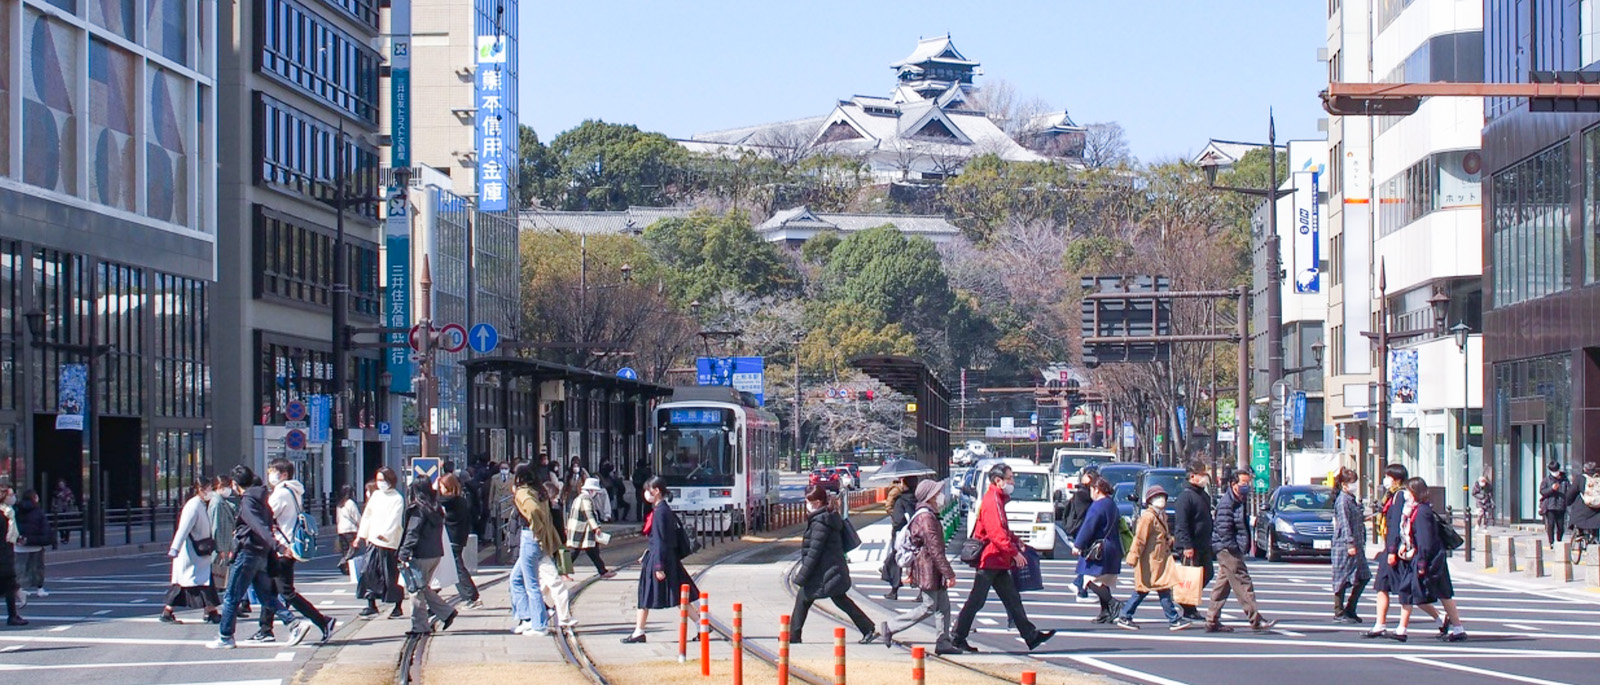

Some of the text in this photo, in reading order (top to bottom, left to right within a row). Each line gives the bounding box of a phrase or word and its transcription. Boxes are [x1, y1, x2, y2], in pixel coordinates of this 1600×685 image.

[482, 70, 502, 203] 熊本信用金庫
[1300, 208, 1309, 235] HIS
[381, 423, 389, 433] P
